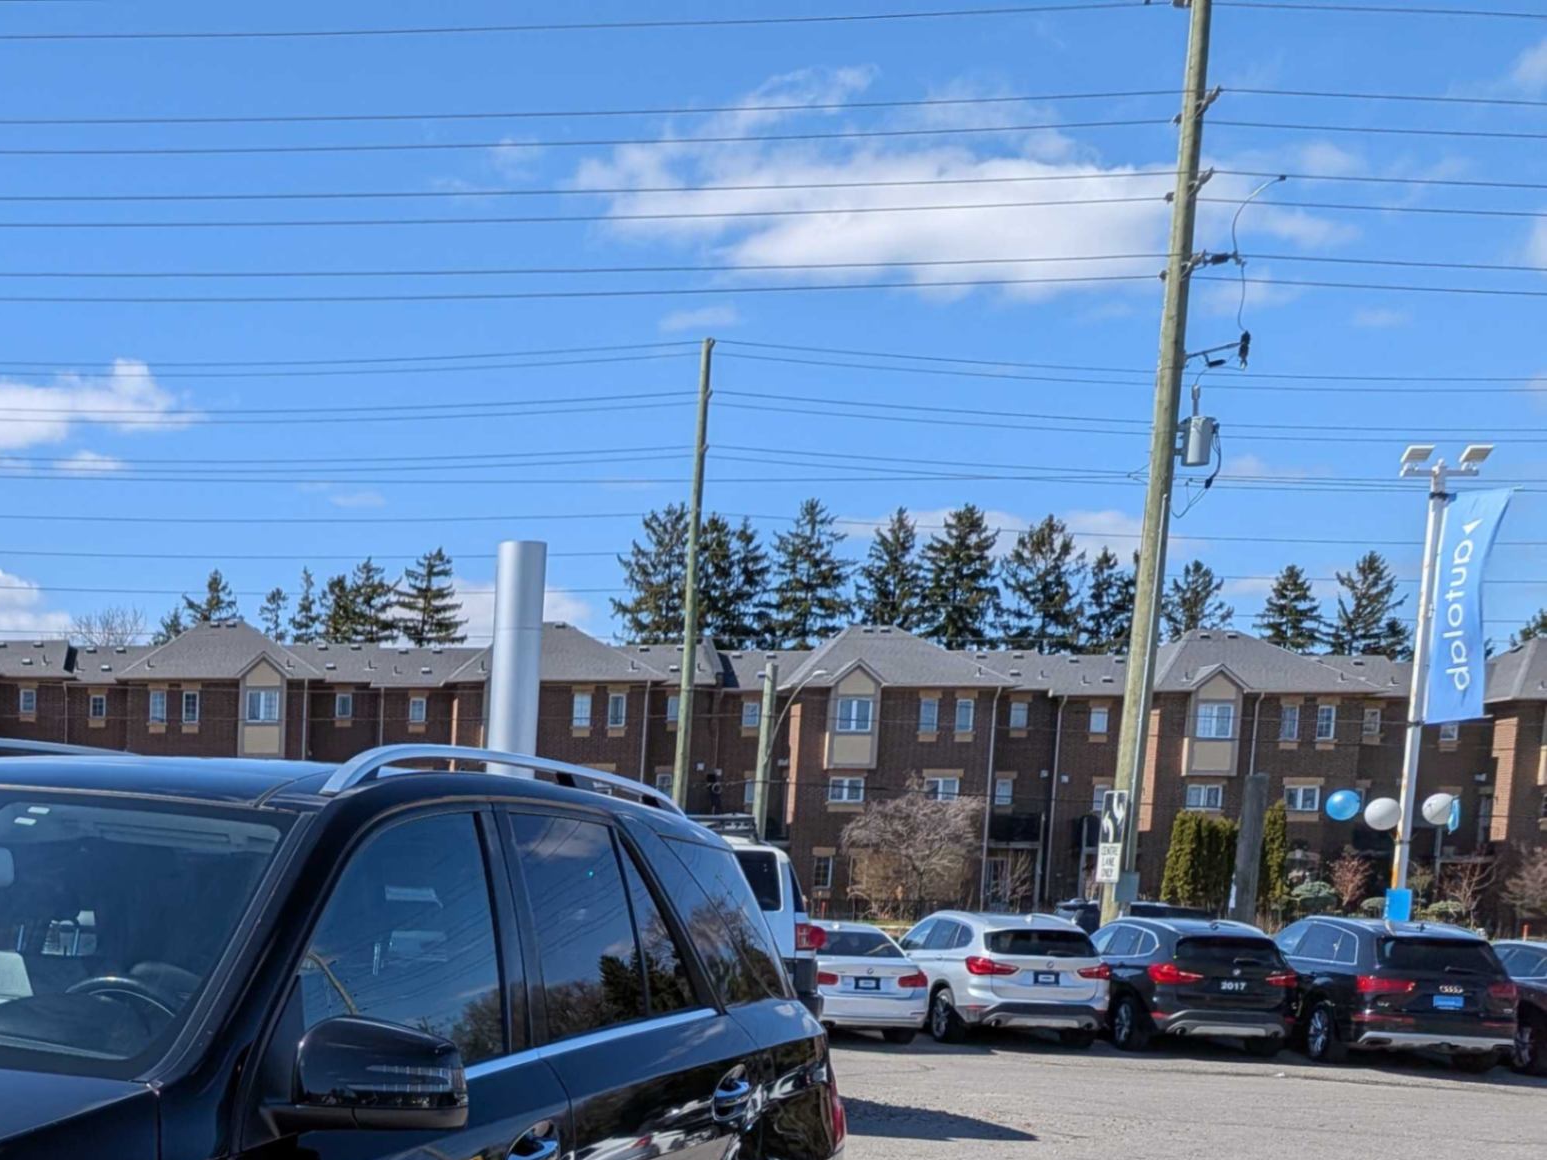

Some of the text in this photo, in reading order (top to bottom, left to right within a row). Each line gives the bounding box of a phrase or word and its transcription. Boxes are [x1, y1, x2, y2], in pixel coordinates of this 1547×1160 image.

[1101, 846, 1118, 856] CENTRE
[1101, 857, 1115, 866] LANE
[1220, 981, 1247, 990] 2017
